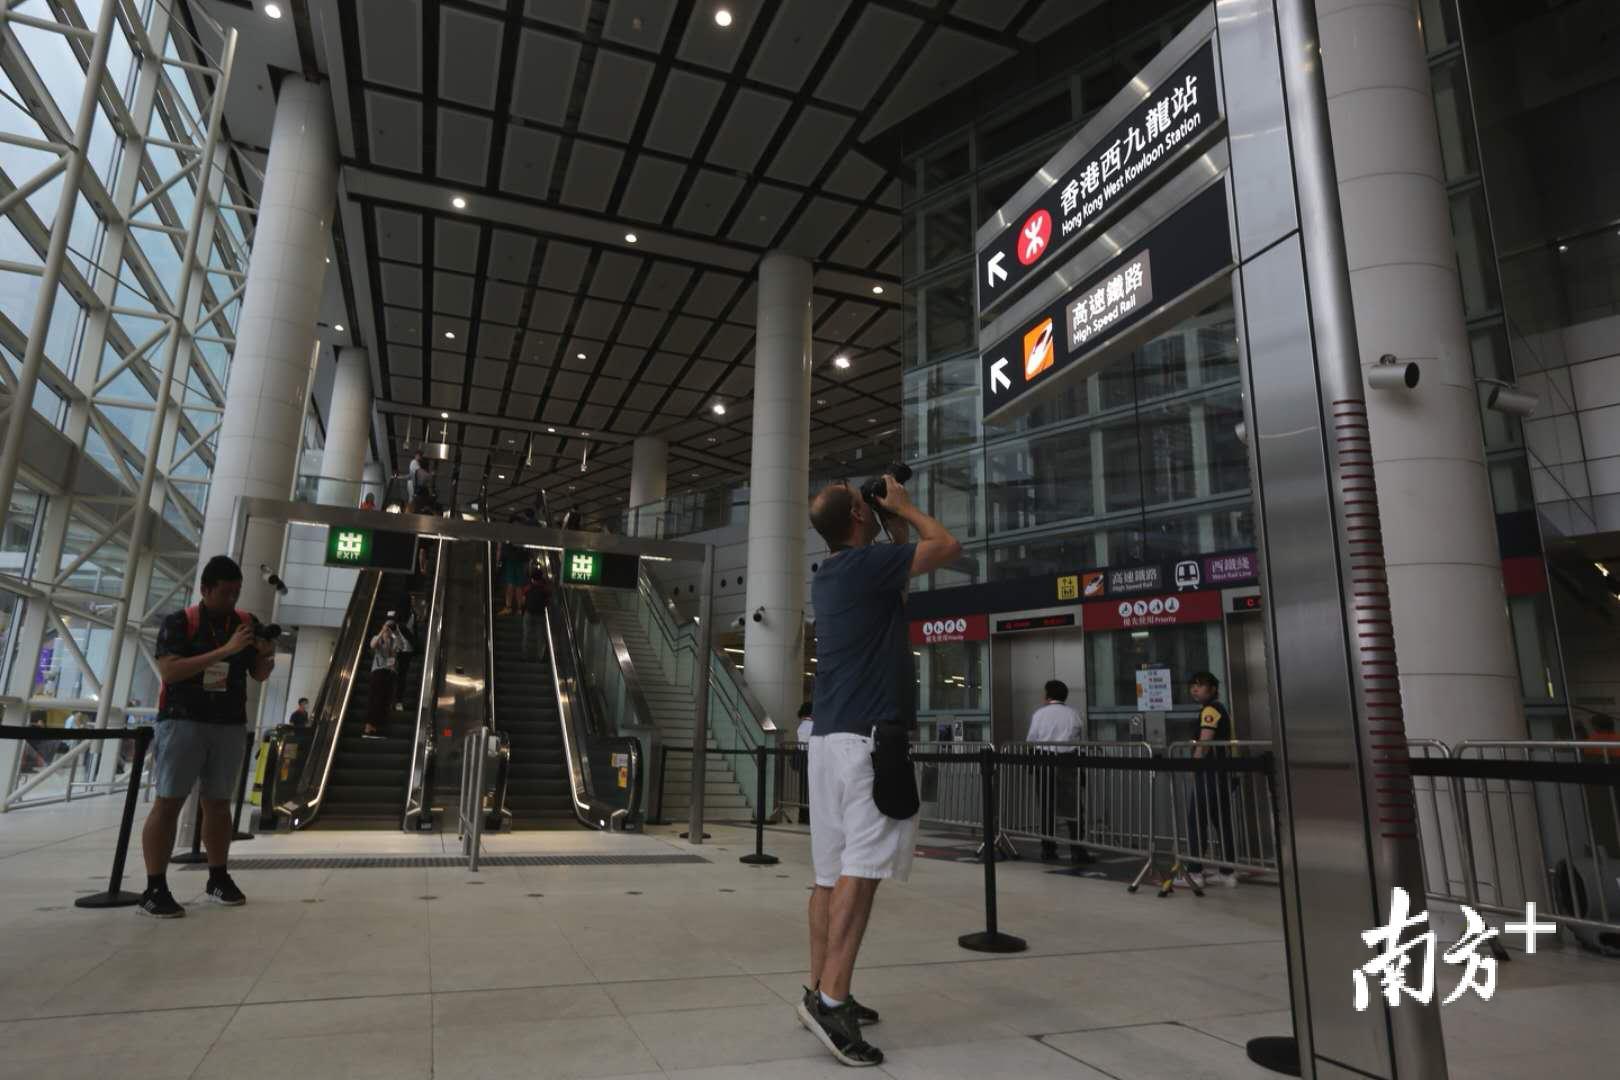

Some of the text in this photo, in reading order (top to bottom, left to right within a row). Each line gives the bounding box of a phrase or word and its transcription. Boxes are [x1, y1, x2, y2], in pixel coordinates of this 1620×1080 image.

[1061, 75, 1197, 215] 香港西九龍站
[1062, 112, 1200, 236] Hong Kong West Kowloon Station
[1072, 262, 1143, 331] 高速鐵路
[1073, 293, 1136, 345] High Speed Rail
[336, 550, 360, 560] EXIT
[338, 532, 362, 551] 出
[571, 571, 592, 580] EXIT
[572, 554, 592, 572] 出
